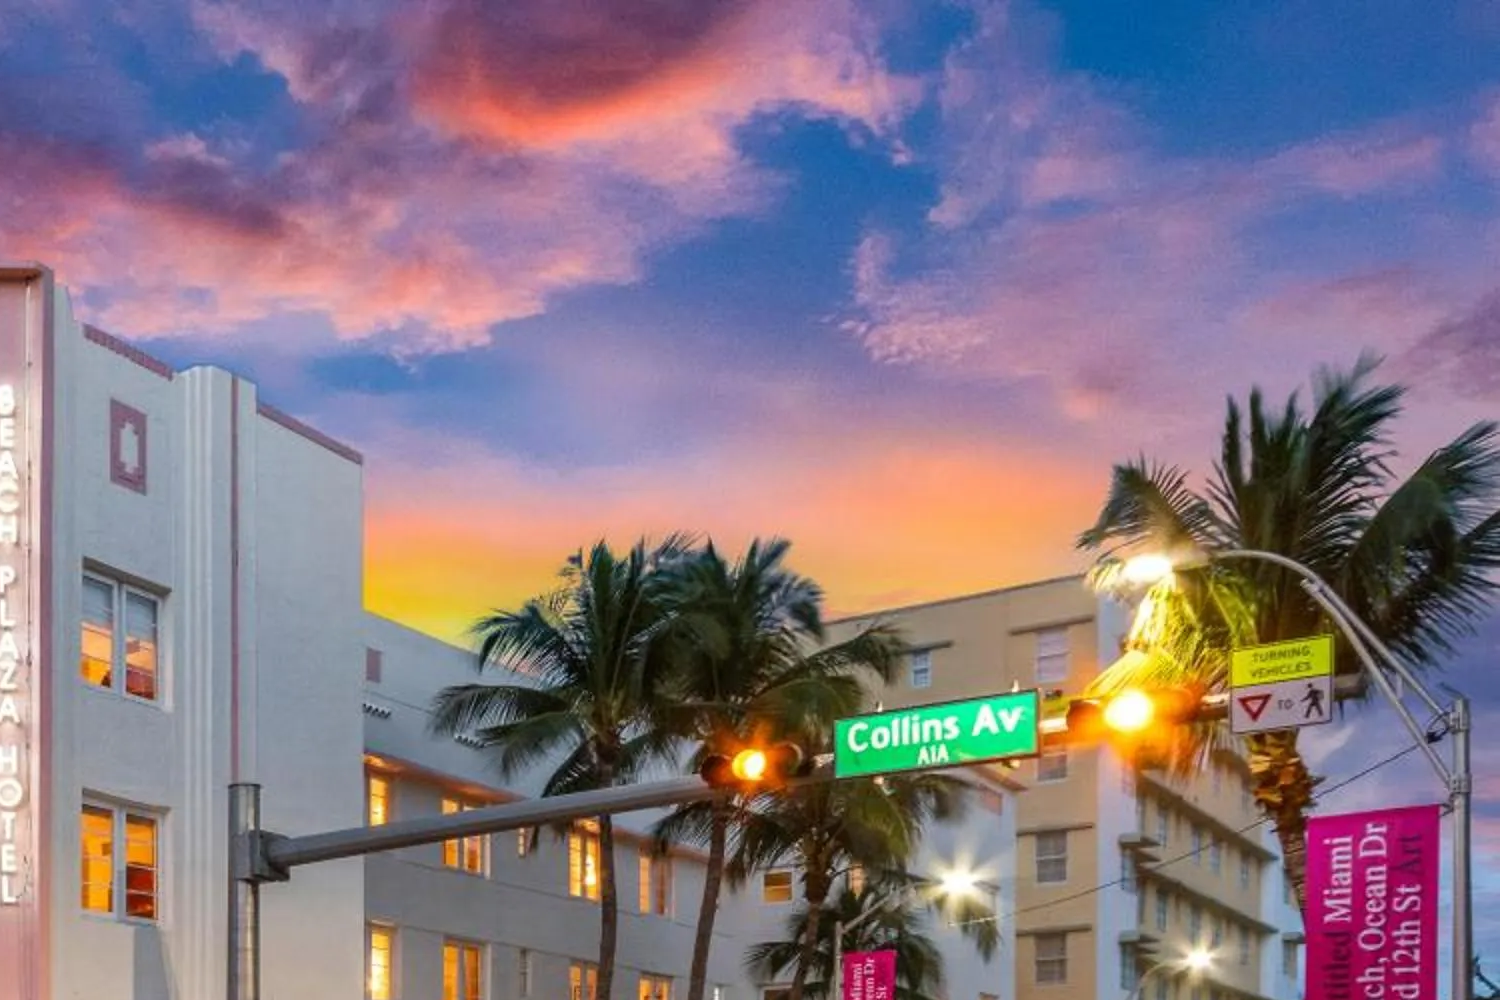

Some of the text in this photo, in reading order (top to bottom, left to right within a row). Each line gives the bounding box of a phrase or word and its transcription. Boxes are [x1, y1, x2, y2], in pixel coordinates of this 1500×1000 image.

[1251, 661, 1313, 679] VEHICLES
[1252, 644, 1312, 663] TURNING
[1277, 697, 1295, 711] TO
[847, 703, 1025, 753] Collins Av
[1359, 821, 1388, 859] Dr
[1395, 833, 1422, 876] Art
[1323, 834, 1353, 924] Miami
[1392, 883, 1422, 912] St
[1357, 863, 1388, 952] Ocean
[1391, 919, 1421, 975] 12th
